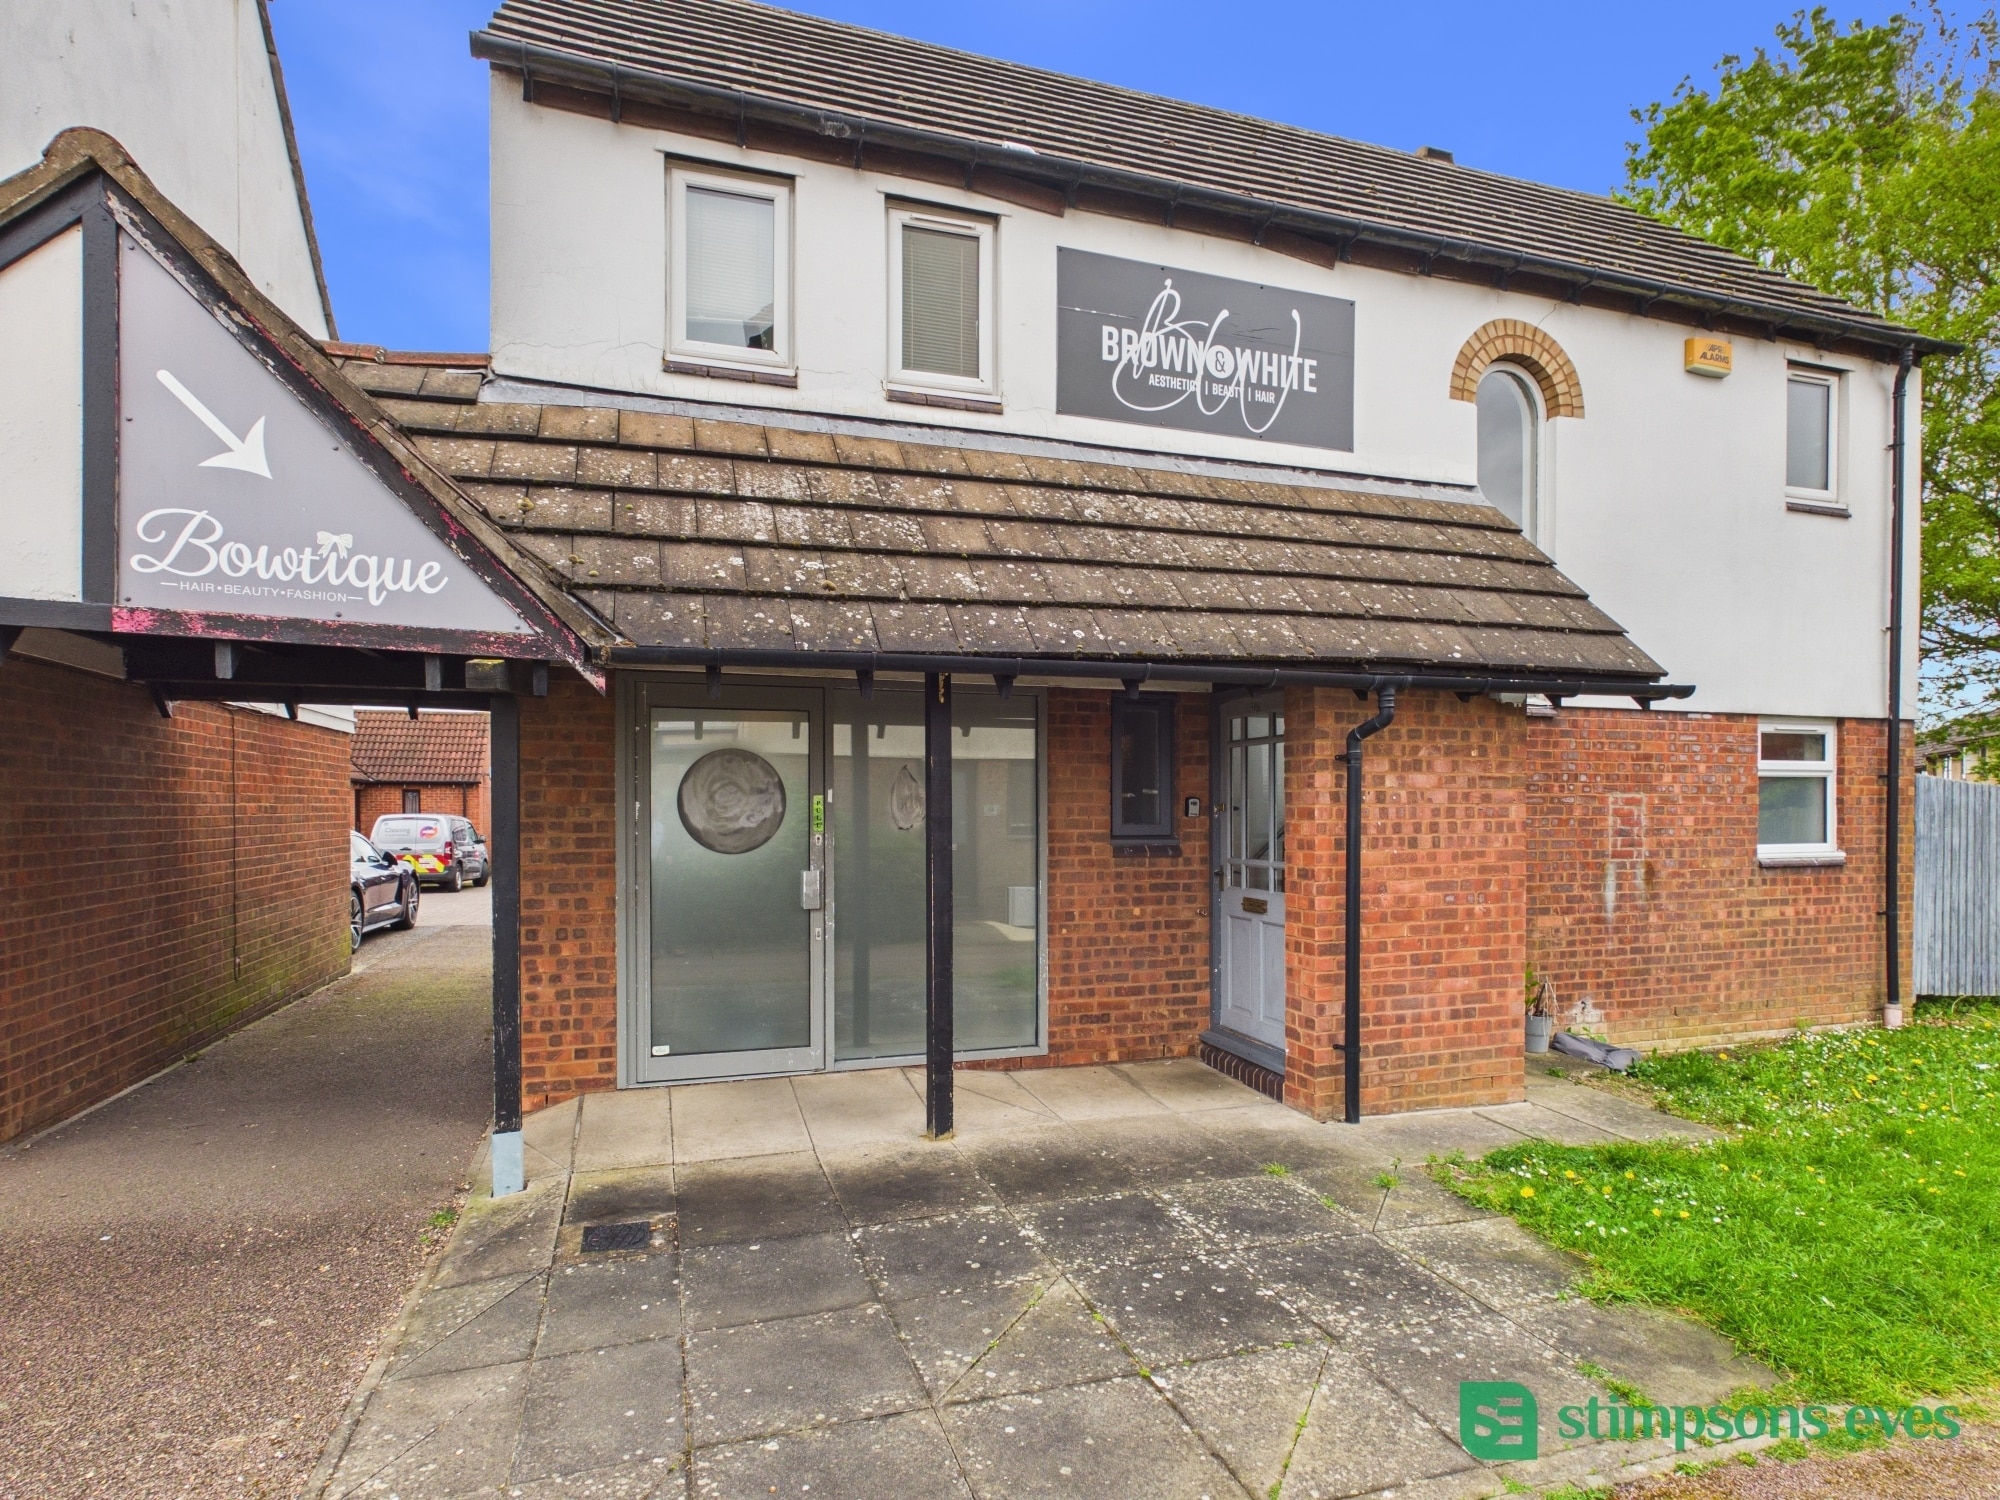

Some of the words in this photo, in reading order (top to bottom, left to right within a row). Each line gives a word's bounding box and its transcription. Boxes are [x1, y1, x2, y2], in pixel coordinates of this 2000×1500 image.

[1102, 325, 1204, 376] BROWN
[1235, 347, 1317, 393] WHITE
[1699, 351, 1729, 364] ALARMS
[1255, 389, 1275, 404] HAIR
[130, 508, 448, 606] Bowtique
[179, 581, 215, 593] HAIR
[224, 584, 279, 597] BEAUTY
[287, 588, 347, 602] FASHION
